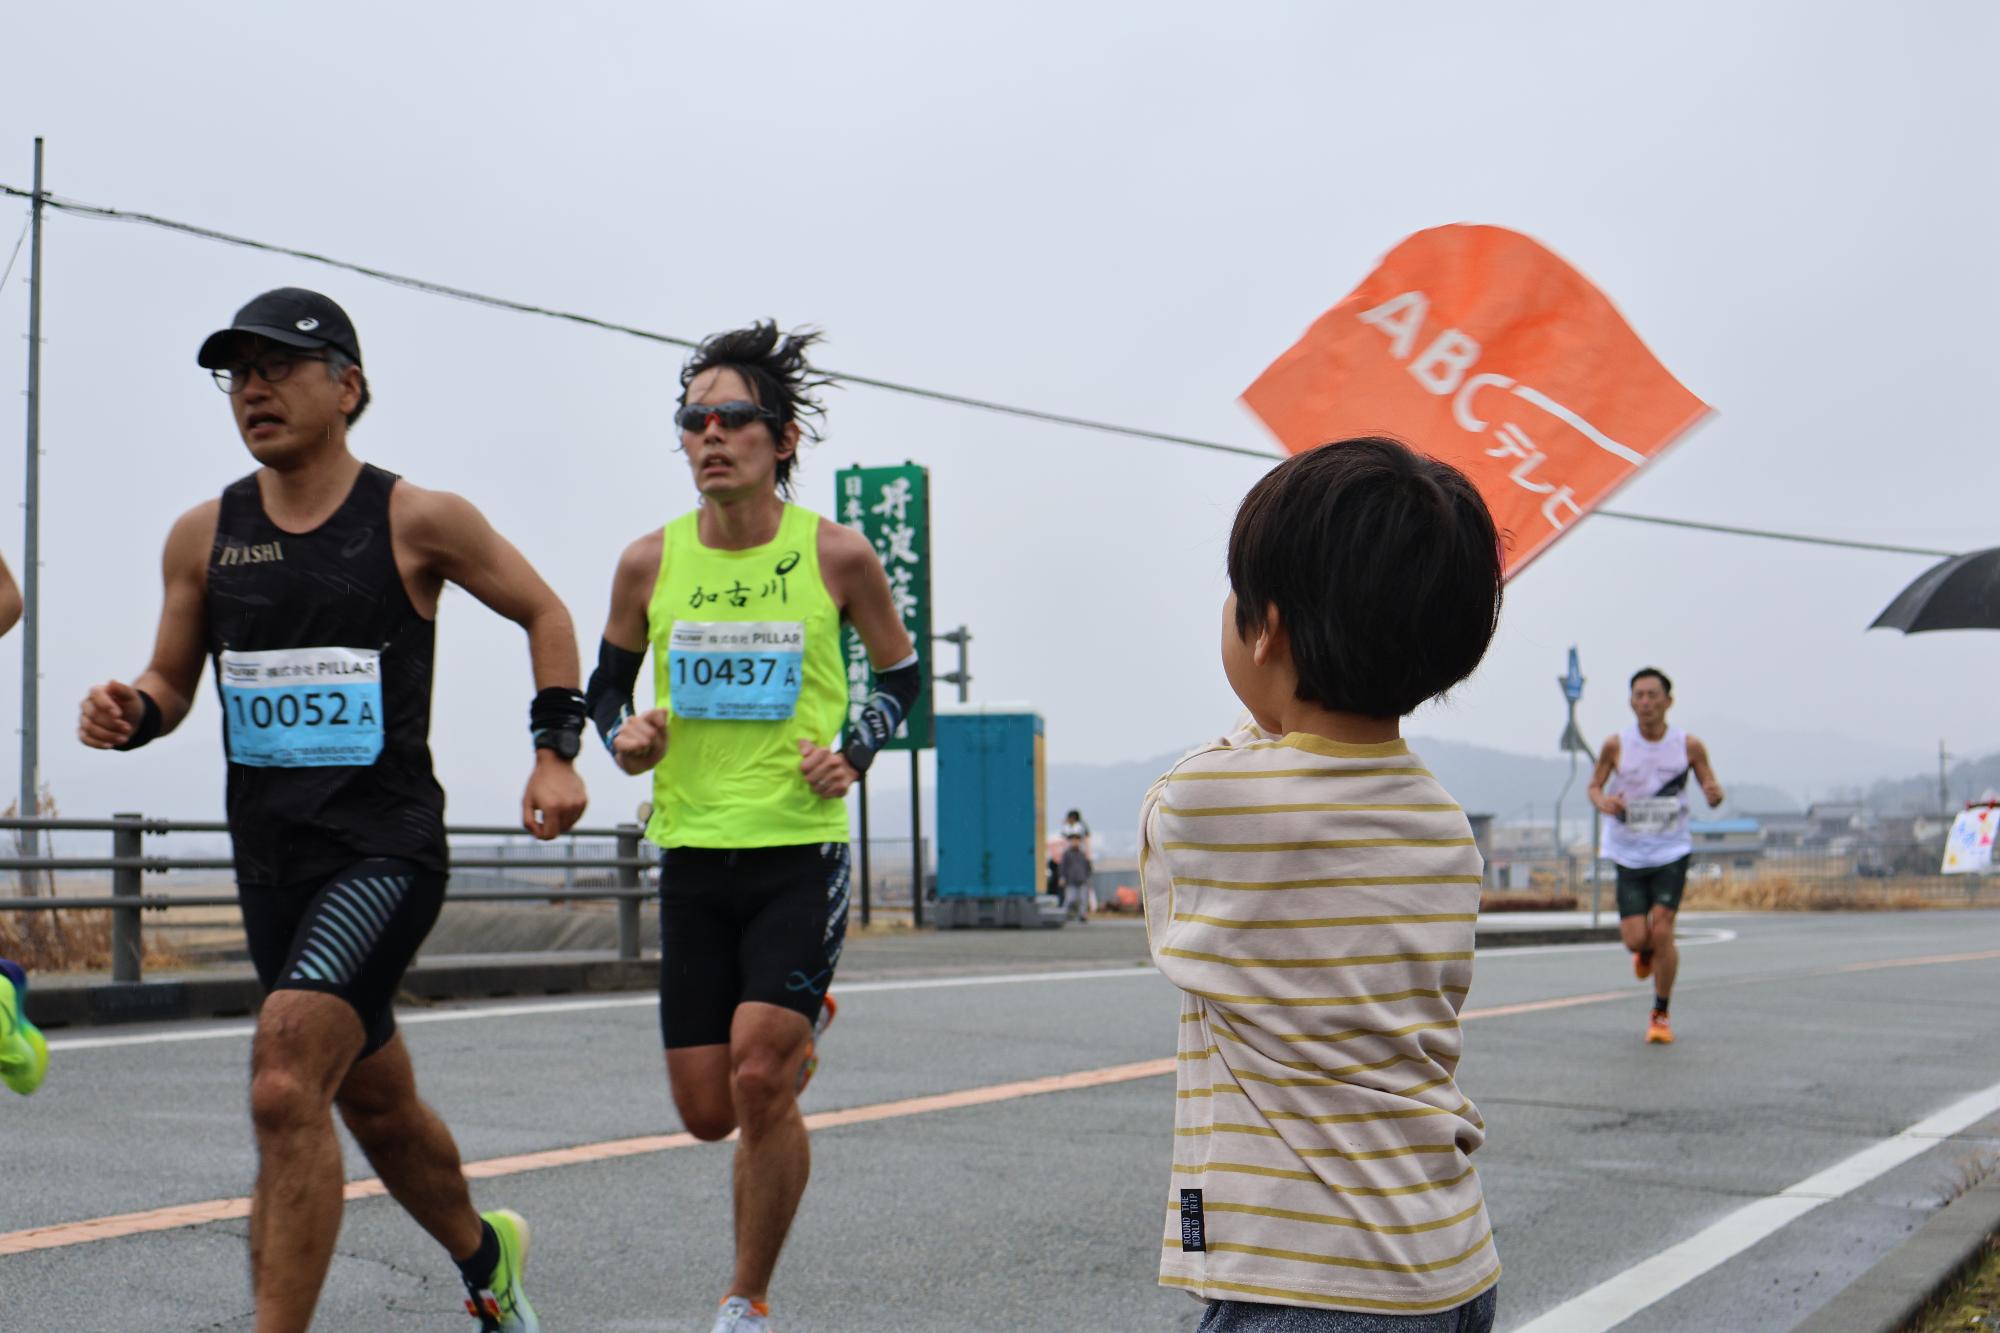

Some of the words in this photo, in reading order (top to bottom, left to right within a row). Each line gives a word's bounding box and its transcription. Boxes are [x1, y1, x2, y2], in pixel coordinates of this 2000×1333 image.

[689, 575, 788, 609] 加古川
[752, 632, 800, 645] PILLAR
[317, 660, 375, 676] PILLAR
[676, 658, 778, 687] 10437
[783, 666, 797, 687] A
[232, 691, 349, 729] 10052
[357, 701, 376, 726] A
[1181, 1195, 1190, 1212] THE
[1189, 1193, 1199, 1215] TRIP
[1182, 1217, 1192, 1245] ROUND
[1190, 1219, 1201, 1247] WORLD
